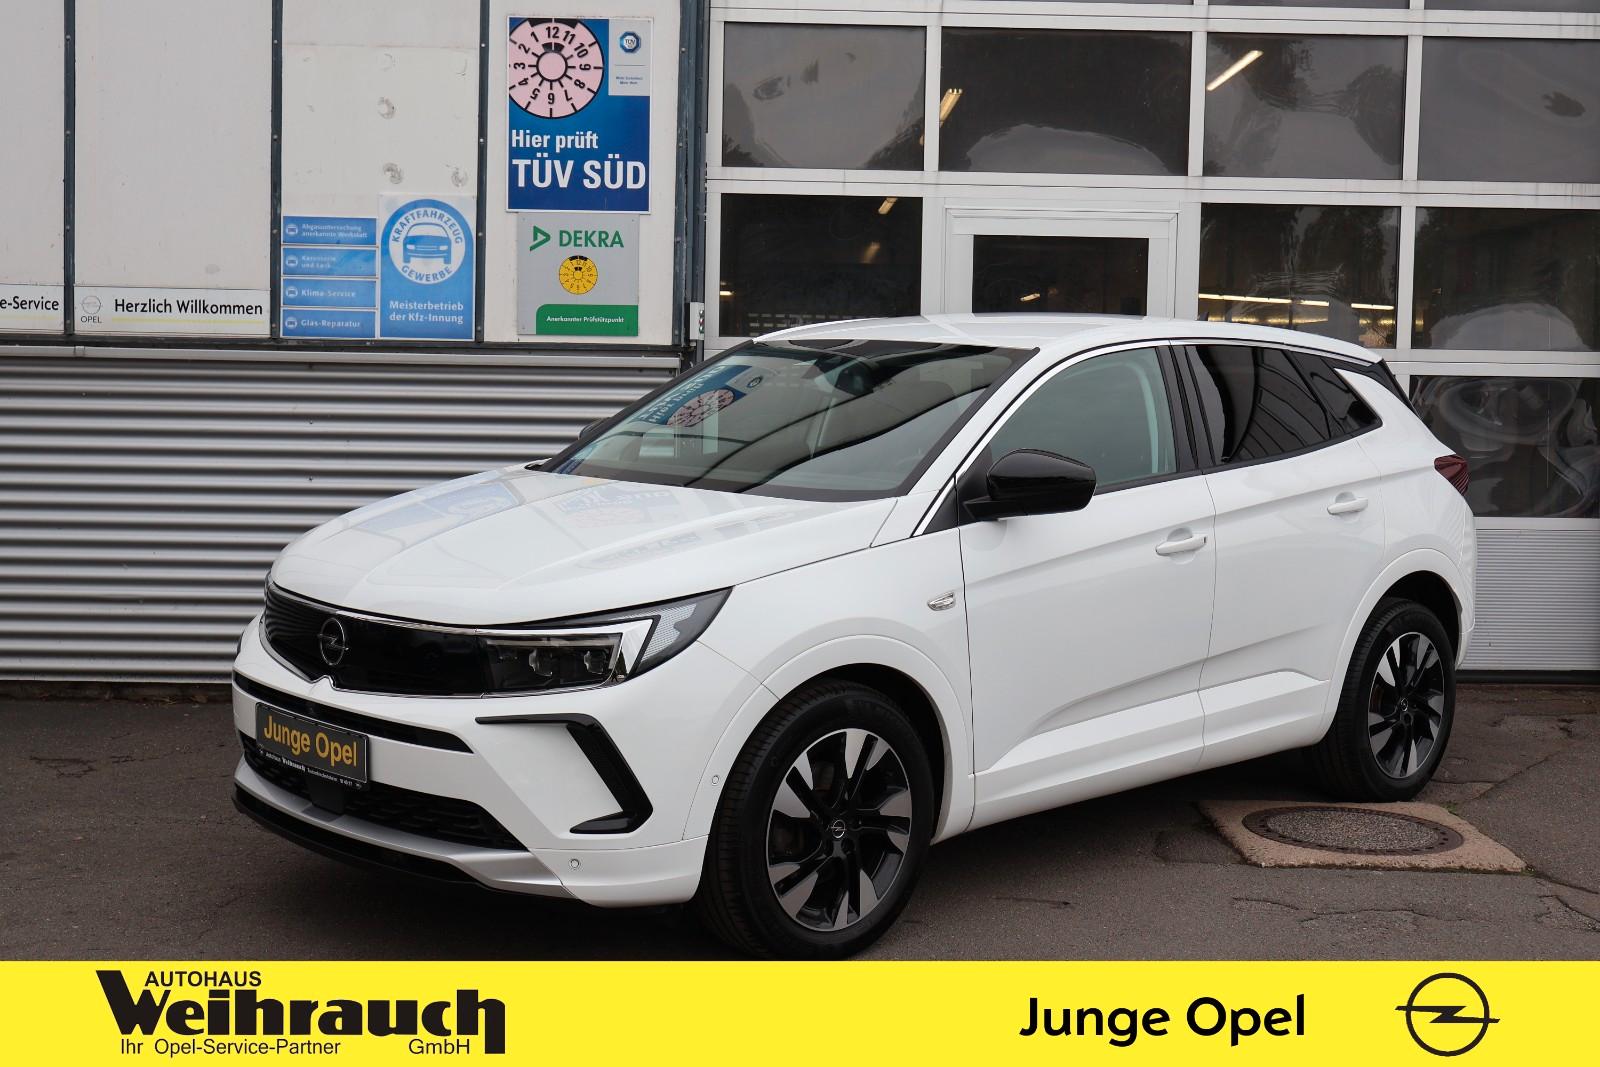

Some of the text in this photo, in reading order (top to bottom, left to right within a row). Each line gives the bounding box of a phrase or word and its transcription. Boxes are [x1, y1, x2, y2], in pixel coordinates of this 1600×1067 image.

[530, 31, 539, 42] 1
[546, 26, 560, 39] 12
[563, 30, 576, 45] 11
[518, 43, 530, 54] 2
[574, 42, 589, 58] 10
[513, 62, 526, 70] 3
[579, 63, 591, 71] 9
[518, 77, 529, 86] 4
[574, 79, 586, 89] 8
[530, 88, 541, 100] 5
[548, 93, 555, 105] 6
[564, 89, 573, 102] 7
[511, 129, 599, 153] Hier prüft
[512, 152, 646, 189] TÜV SÜD
[392, 209, 463, 244] KRAFTFAHRZEUG
[559, 230, 624, 248] DEKRA
[401, 265, 453, 282] GEWERBE
[301, 289, 356, 297] Klima-Service
[115, 298, 263, 315] Herzlich Willkommen
[389, 300, 464, 311] Meisterbetrieb
[81, 315, 102, 324] OPEL
[301, 320, 360, 328] Glas-Reparatur
[389, 312, 463, 324] der Kfz-Innung
[264, 715, 357, 767] Junge Opel
